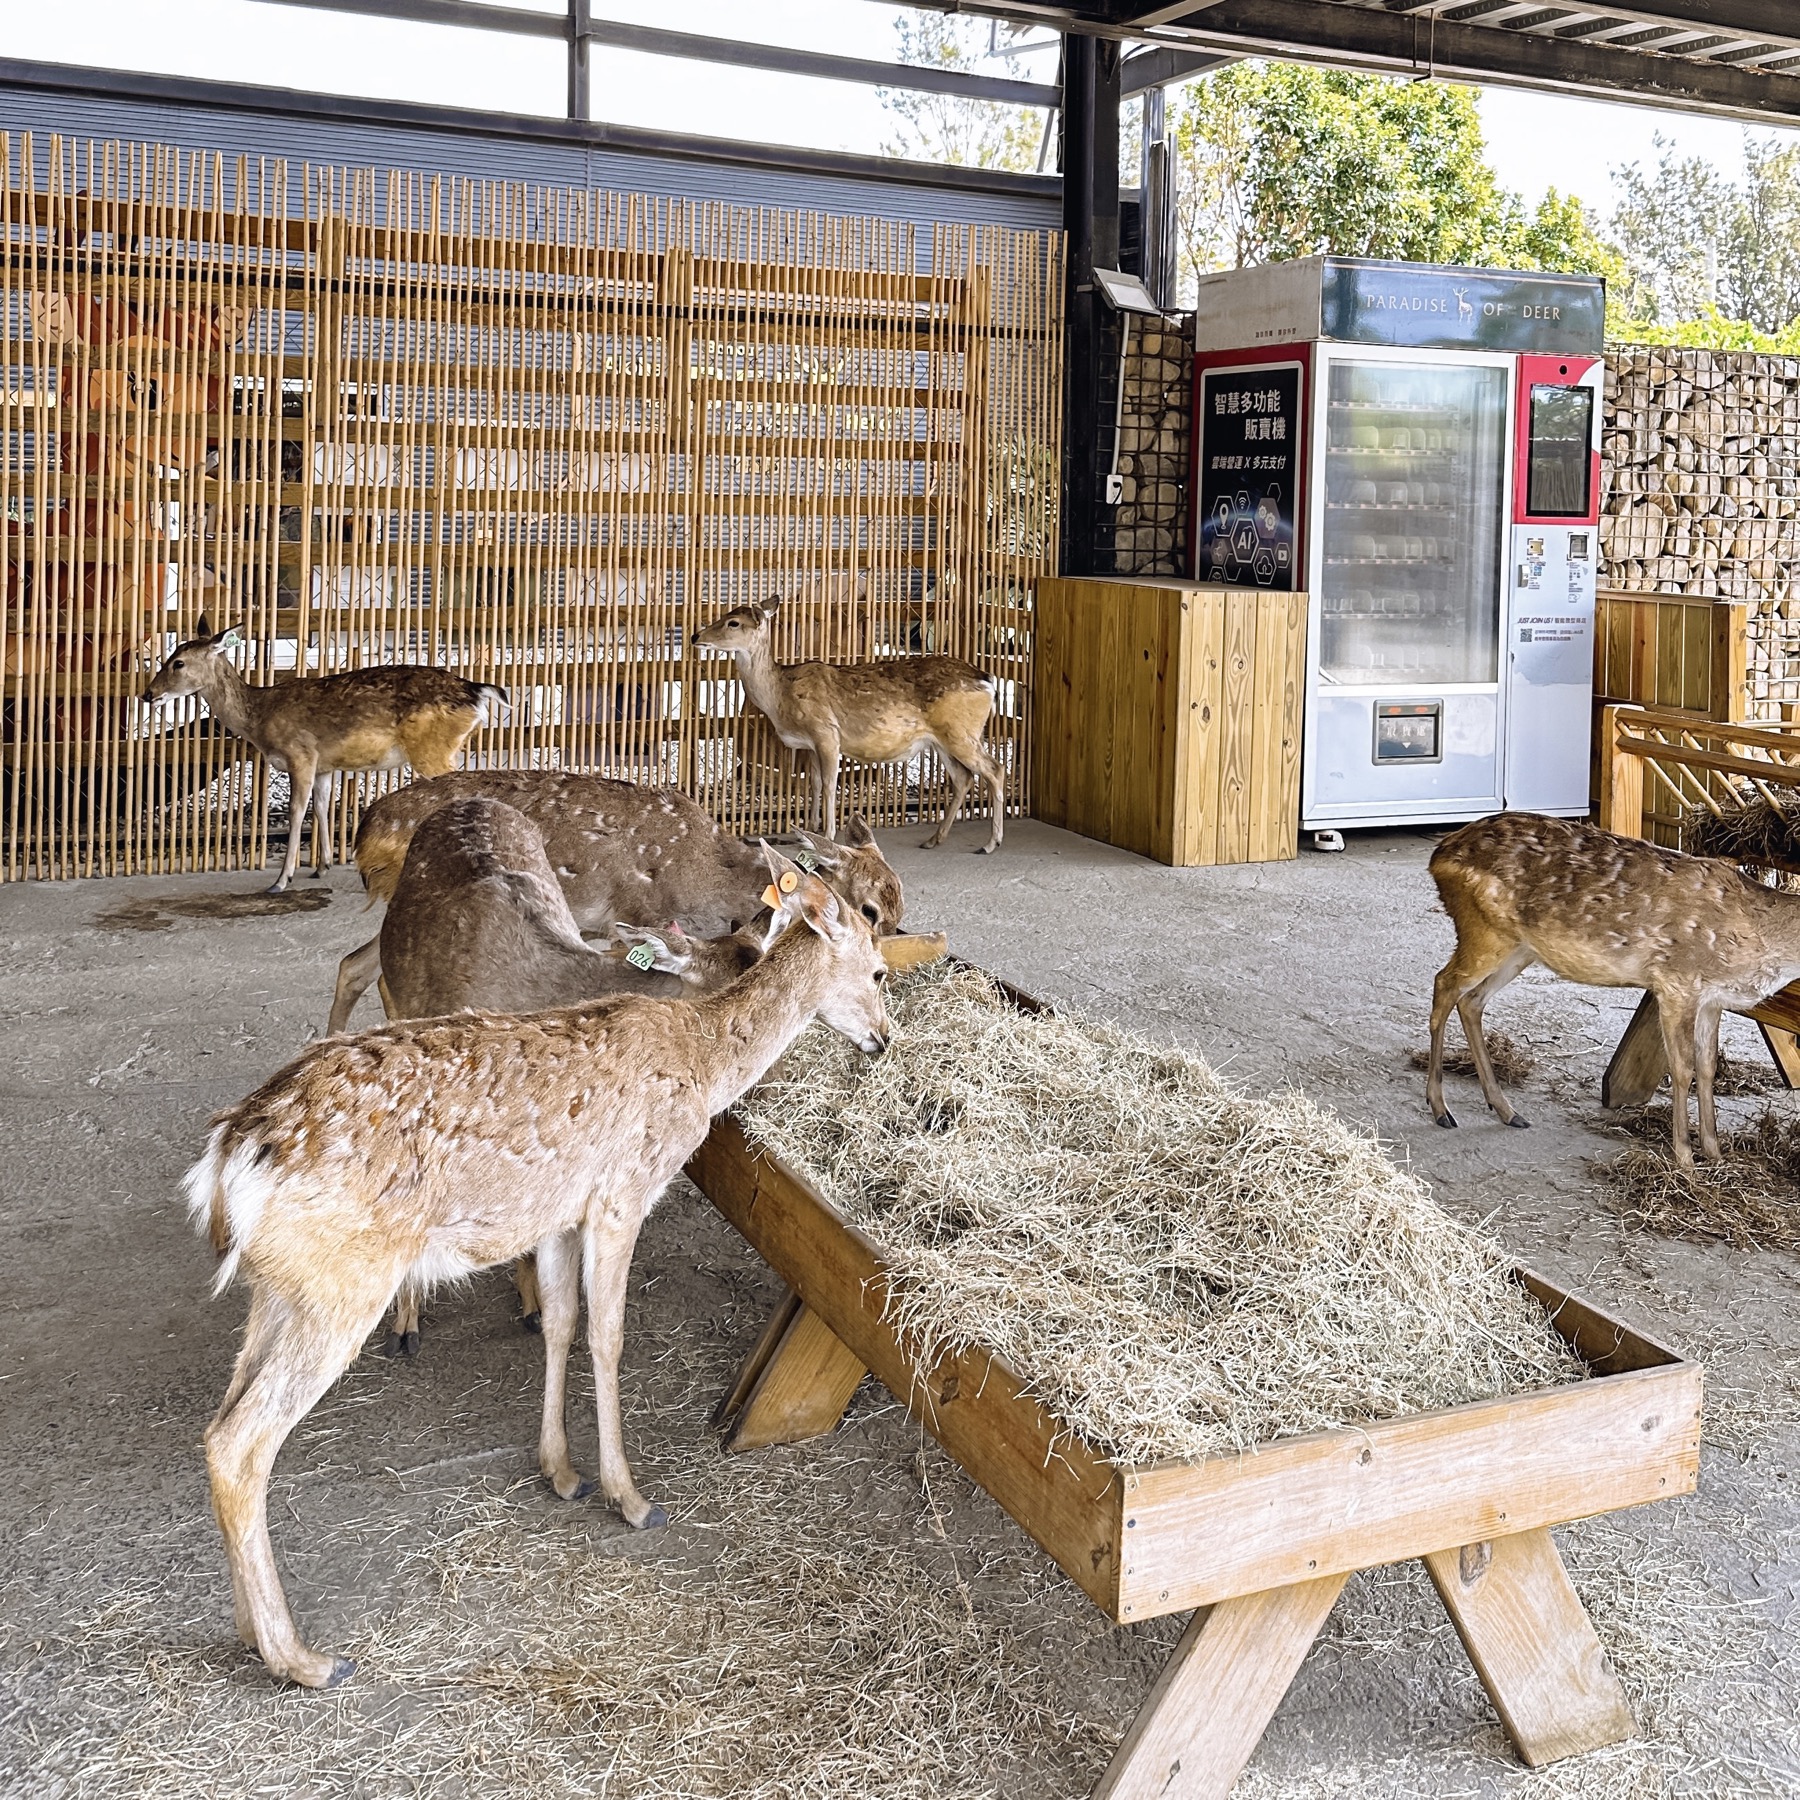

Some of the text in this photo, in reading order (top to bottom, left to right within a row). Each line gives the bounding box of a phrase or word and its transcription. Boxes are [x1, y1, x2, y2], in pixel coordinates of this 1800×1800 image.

[1367, 294, 1561, 321] PARADISE OF DEER
[1214, 389, 1281, 415] 智慧多功能
[1244, 416, 1286, 440] 販賣機
[1252, 455, 1287, 470] 多元支付
[1237, 531, 1252, 550] AI
[629, 950, 651, 967] 026
